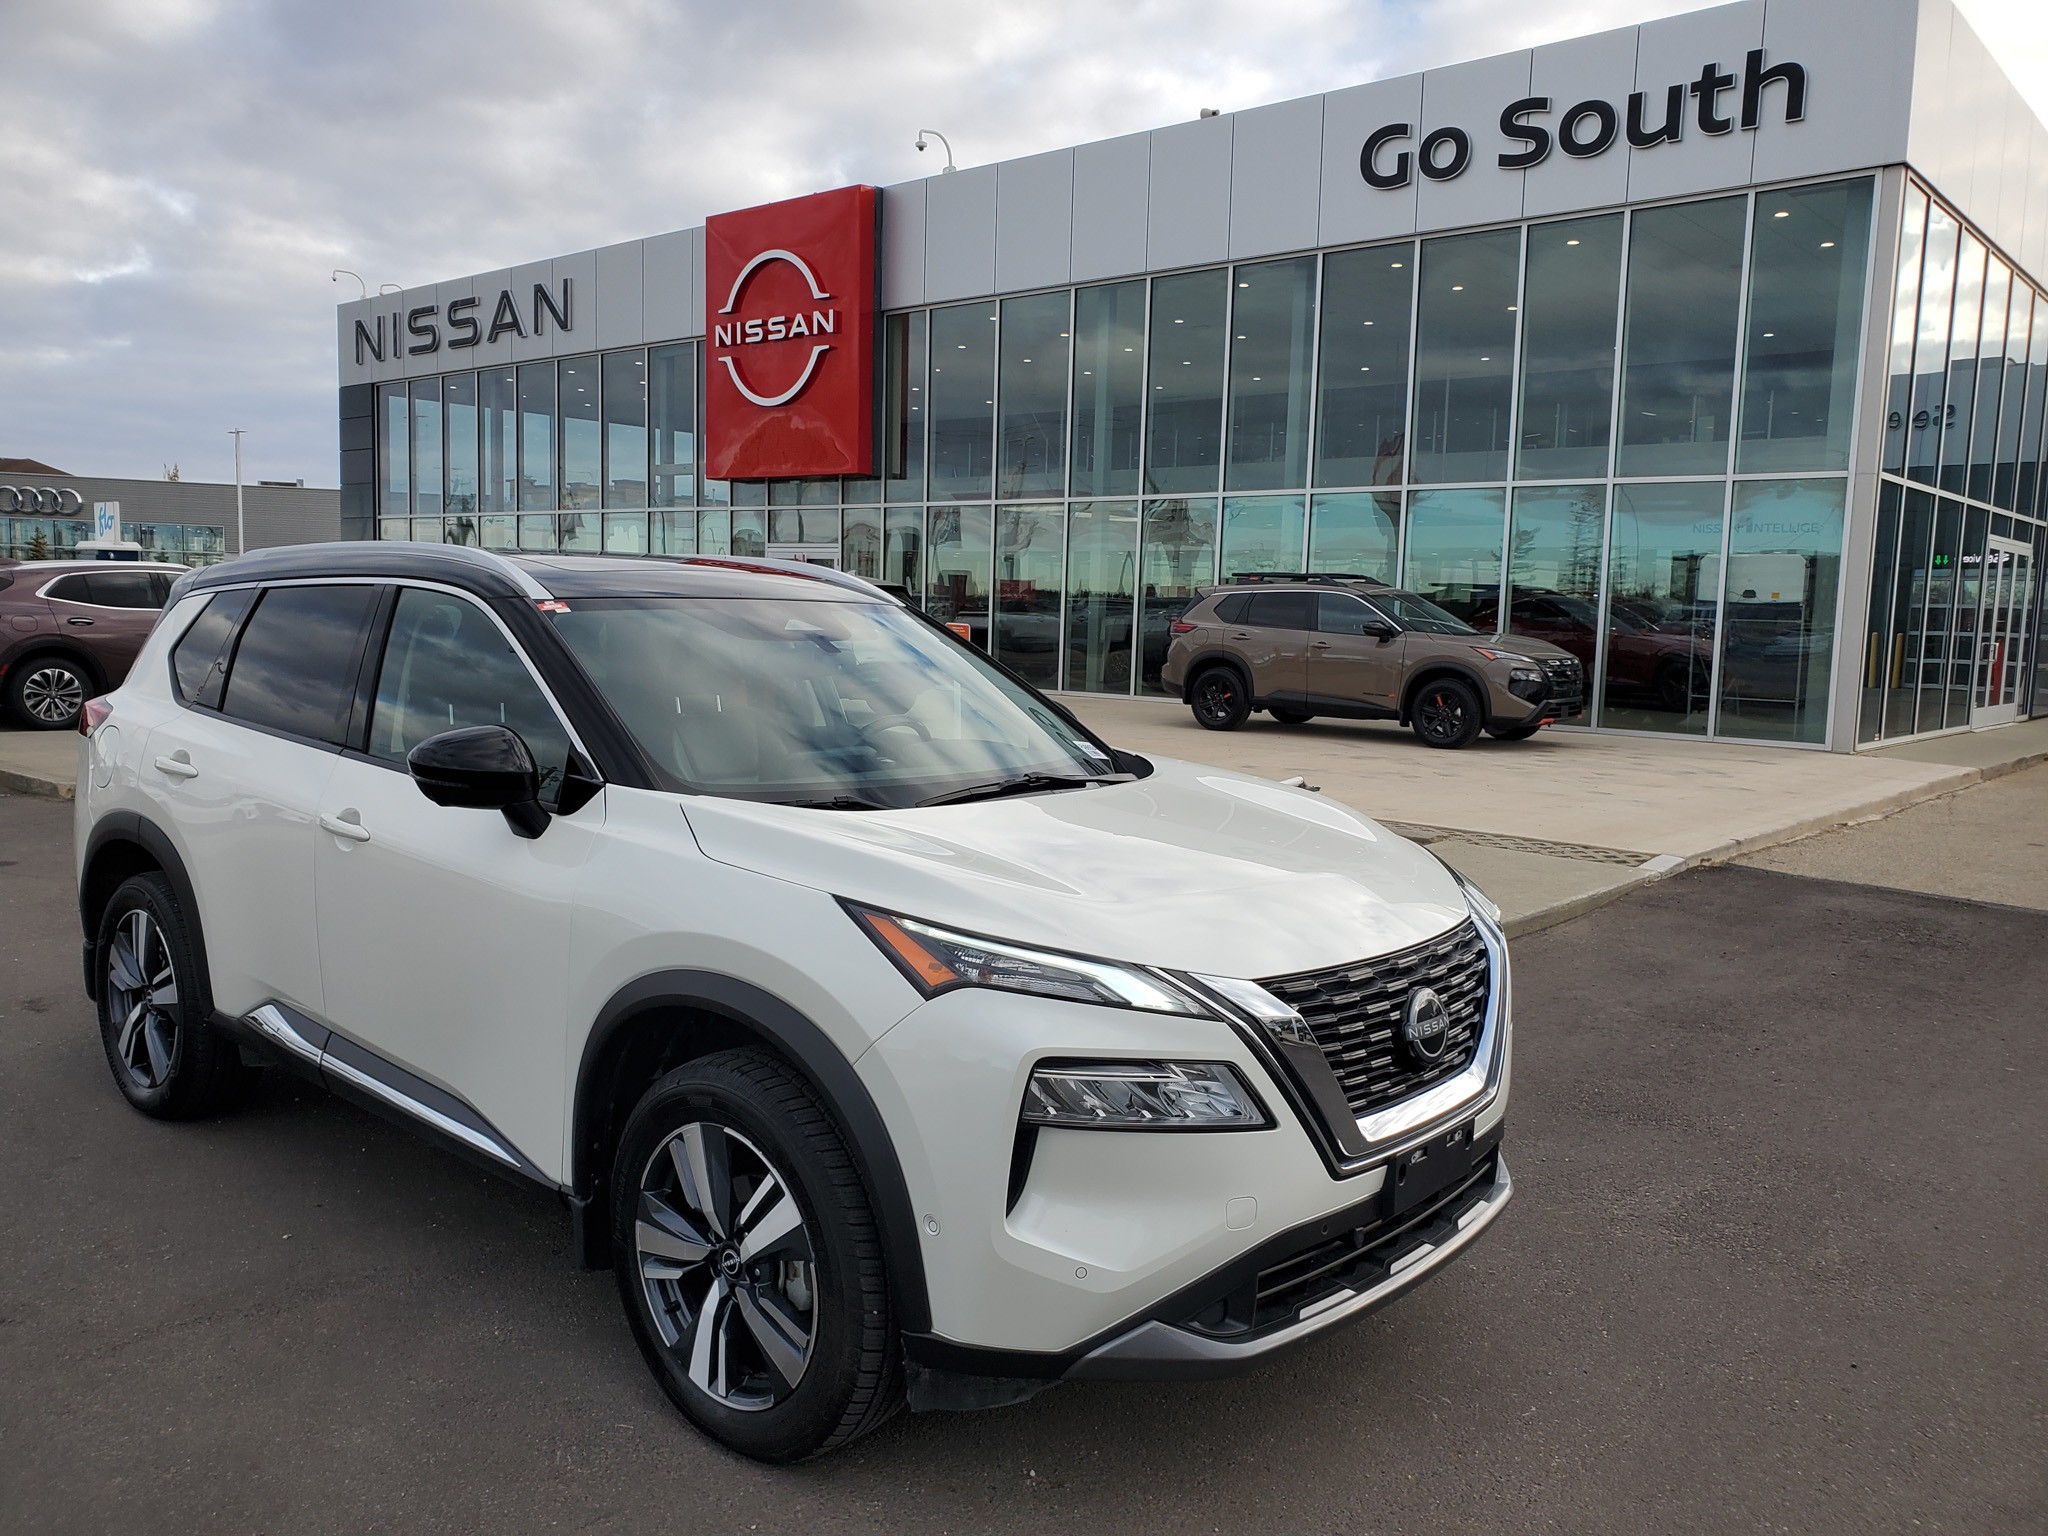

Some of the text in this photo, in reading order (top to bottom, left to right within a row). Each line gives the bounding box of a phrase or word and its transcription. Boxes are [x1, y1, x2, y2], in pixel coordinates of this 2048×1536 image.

[1360, 47, 1808, 190] Go South
[355, 277, 573, 366] NISSAN
[715, 308, 834, 347] NISSAN
[98, 502, 114, 537] flo
[1409, 1016, 1449, 1039] NISSAN
